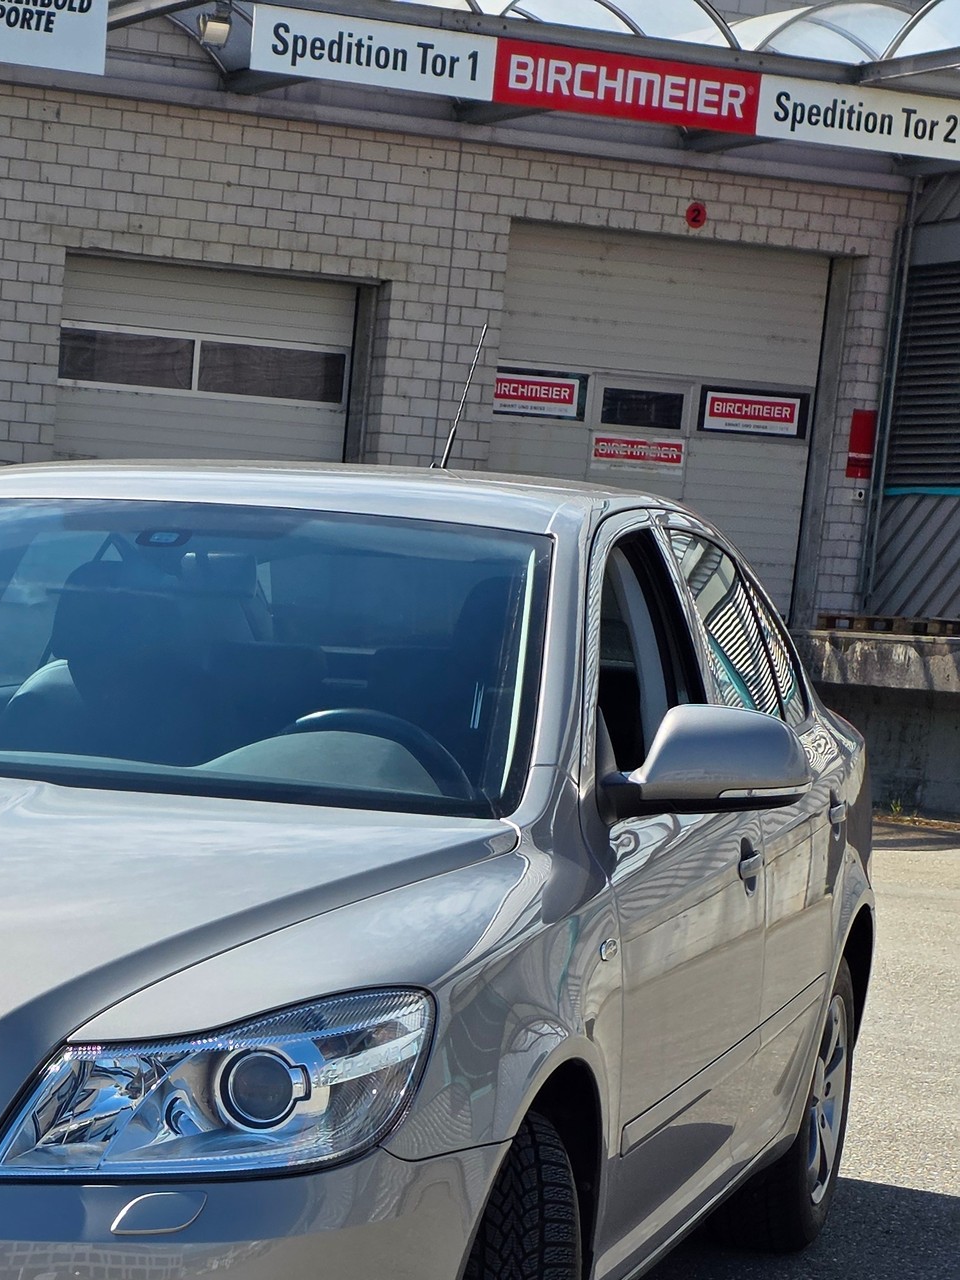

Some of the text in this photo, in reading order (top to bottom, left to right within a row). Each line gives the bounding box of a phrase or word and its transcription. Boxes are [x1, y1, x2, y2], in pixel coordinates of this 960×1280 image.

[271, 22, 479, 81] Spedition Tor 1
[508, 54, 747, 118] BIRCHMEIER
[773, 91, 959, 144] Spedition Tor 2
[690, 208, 701, 223] 2
[495, 382, 570, 400] IRCHMEIER
[713, 401, 791, 418] BIRCHMEIER
